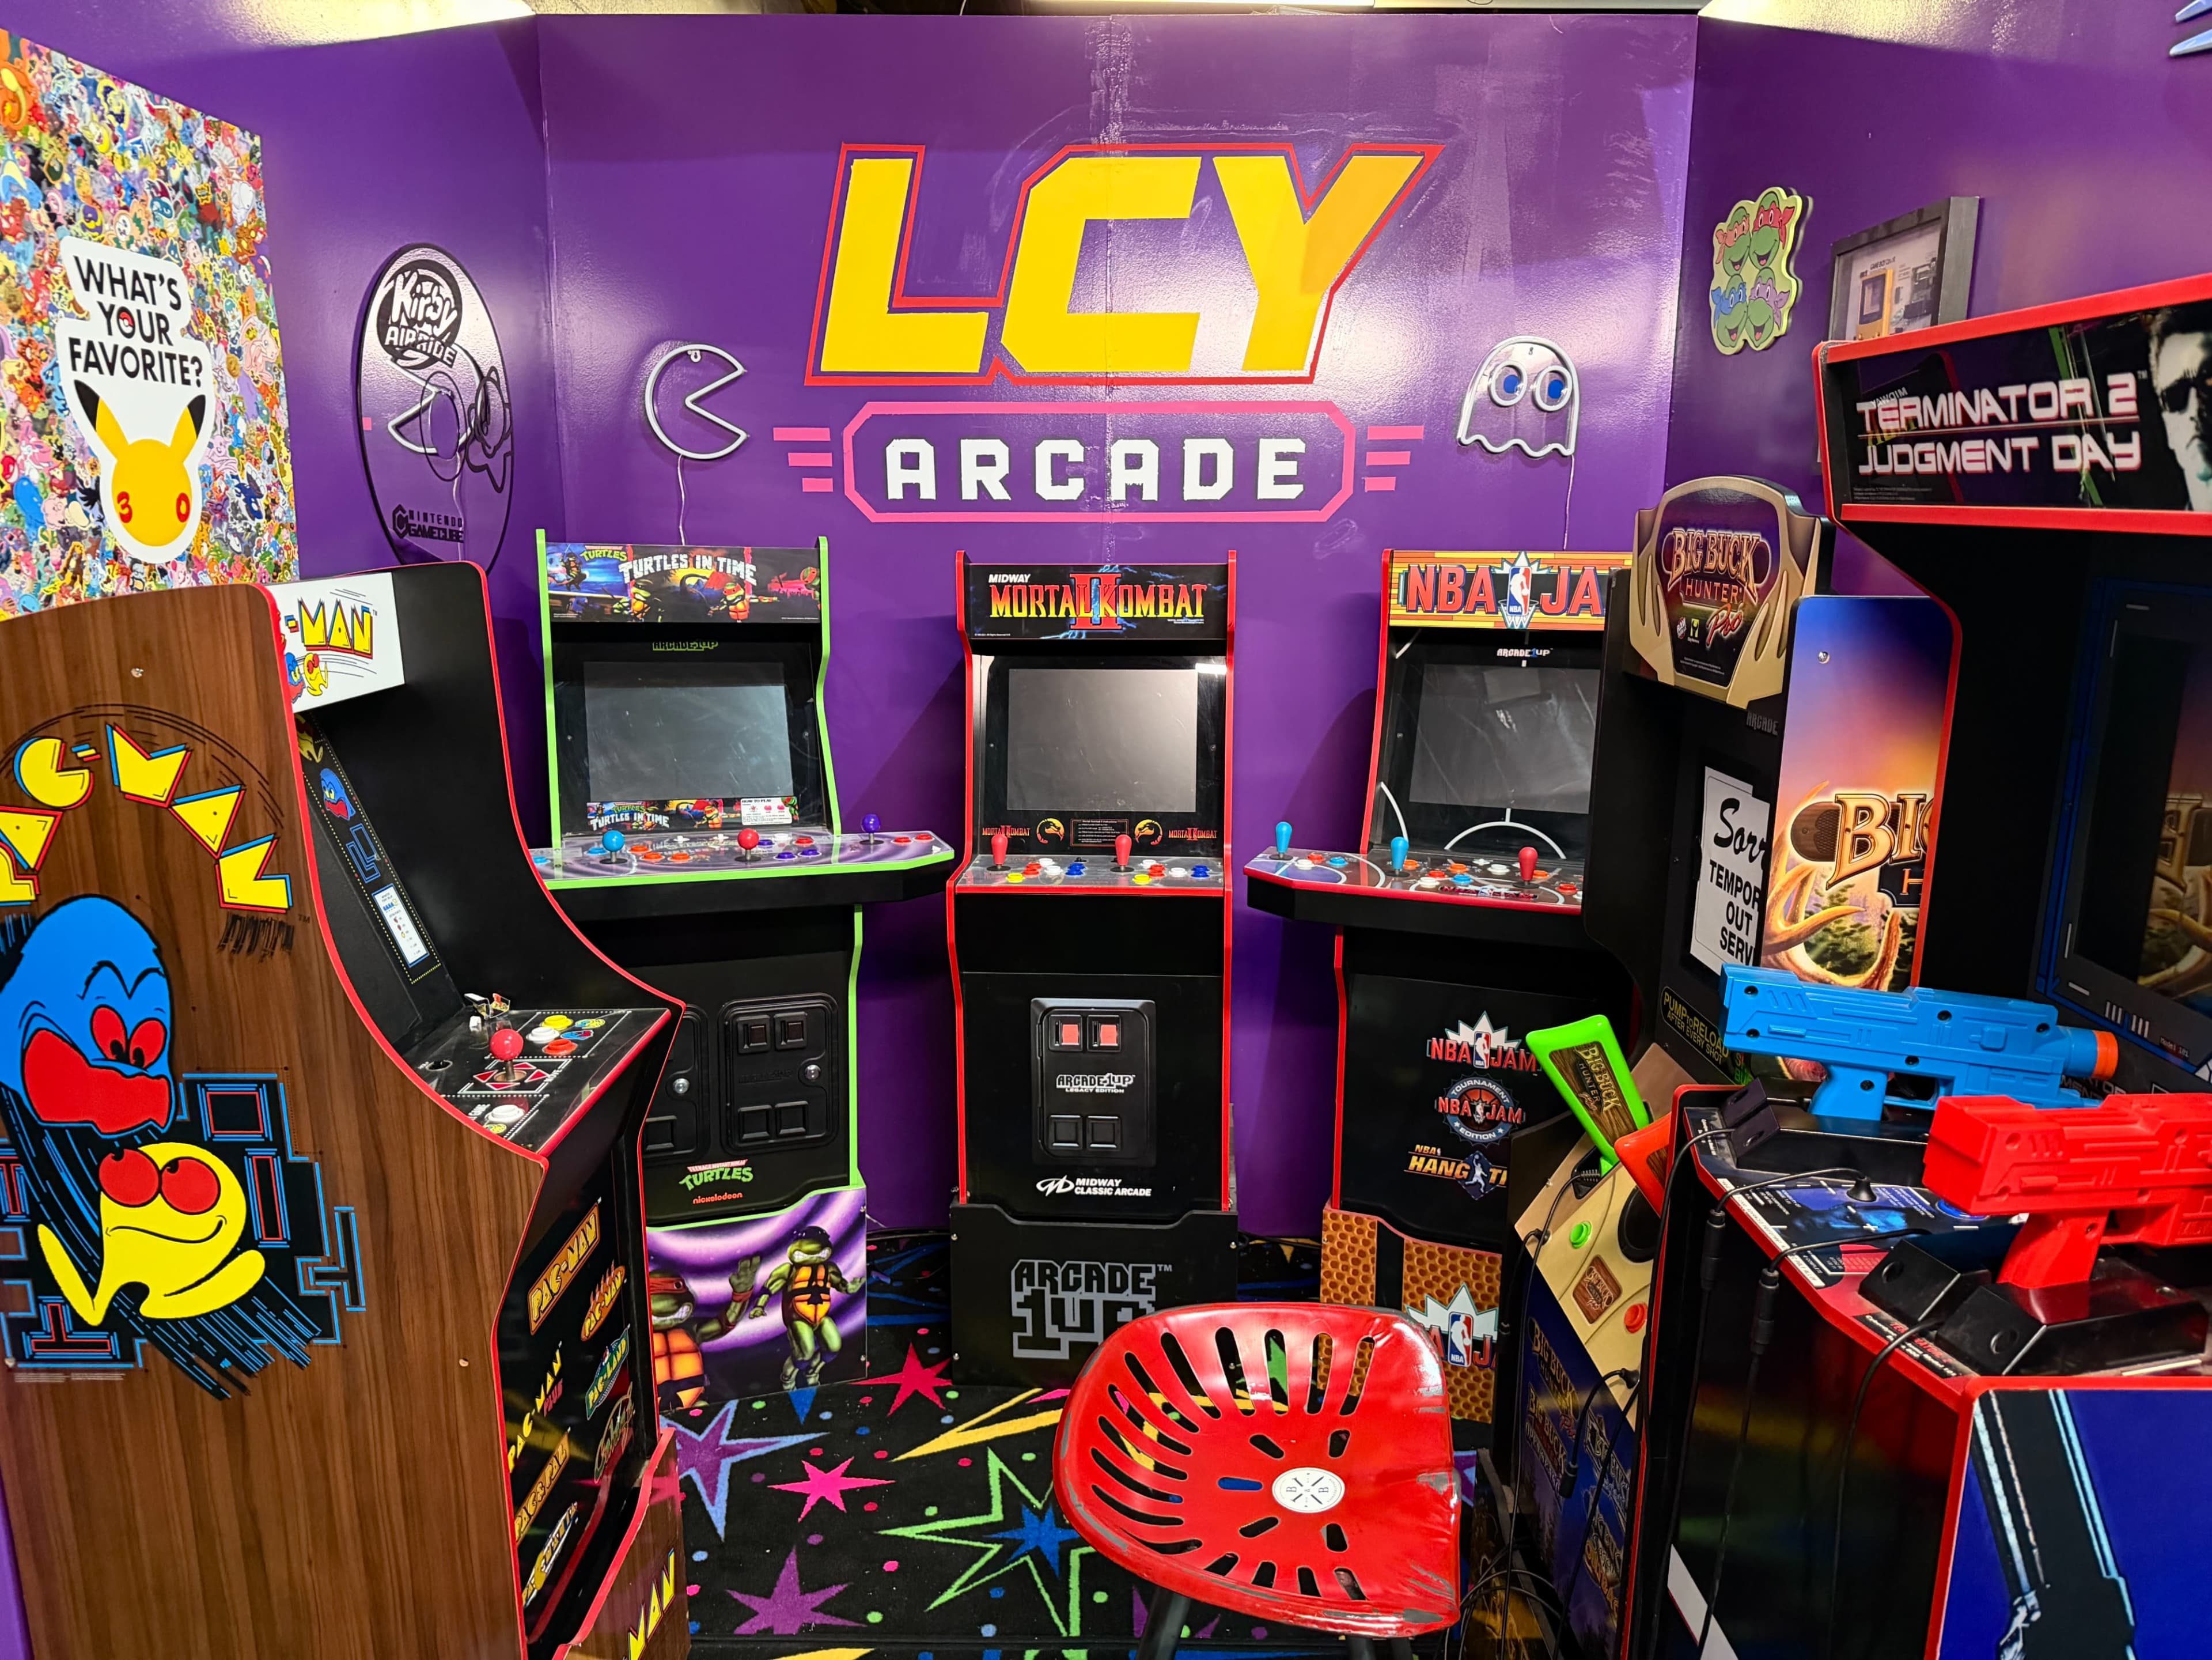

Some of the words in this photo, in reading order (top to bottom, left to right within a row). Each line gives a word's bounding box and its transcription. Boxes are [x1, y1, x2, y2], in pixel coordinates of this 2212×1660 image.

[815, 152, 1427, 376] LCY
[392, 271, 457, 338] Kirby
[97, 301, 173, 346] YOUR
[69, 336, 202, 387] FAVORITE?
[1856, 378, 2095, 433] TERMINATOR
[2107, 372, 2139, 416] 2
[885, 438, 1305, 500] ARCADE
[1858, 436, 2040, 475] JUDGMENT
[2051, 432, 2142, 474] DAY
[408, 509, 463, 528] NINTENDO
[408, 523, 464, 543] GAMECUBE
[579, 549, 627, 562] TURTLES
[618, 553, 689, 585] TURTLES
[696, 554, 713, 570] IN
[717, 555, 758, 587] TIME
[1668, 528, 1703, 591] BIG
[1703, 531, 1758, 605] BUCK
[988, 574, 1031, 584] MIDWAY
[1406, 564, 1499, 615] NBA
[1539, 565, 1611, 617] JA
[1685, 578, 1741, 604] HUNTER
[989, 584, 1093, 618] MORTAL
[1097, 583, 1208, 618] KOMBAT
[1509, 606, 1522, 614] NBA
[590, 812, 630, 831] TURTLES
[634, 812, 645, 821] IN
[646, 813, 670, 829] TIME
[1006, 827, 1031, 838] KOMBAT
[1168, 830, 1192, 838] MORTAL
[1192, 830, 1217, 839] KOMBAT
[1726, 901, 1753, 936] OUT
[1664, 992, 1688, 1020] PUMP
[1686, 1015, 1694, 1027] TO
[1430, 1037, 1471, 1064] NBA
[1490, 1046, 1537, 1072] JAM
[1666, 1012, 1685, 1033] AFTER
[1685, 1026, 1705, 1049] EVERY
[1705, 1043, 1724, 1065] SHOT
[1451, 1079, 1510, 1105] TOURNAMENT
[1574, 1043, 1603, 1073] BIG
[1596, 1069, 1622, 1112] BUCK
[1578, 1062, 1601, 1103] HUNTER
[1437, 1096, 1472, 1117] NBA
[1485, 1104, 1523, 1125] JAM
[1414, 1144, 1437, 1155] NBA
[1459, 1126, 1497, 1140] EDITION
[679, 1167, 754, 1192] TURTLES
[1075, 1178, 1122, 1187] MIDWAY
[1408, 1155, 1471, 1179] HANG
[692, 1192, 744, 1204] nickelodeon
[1074, 1187, 1114, 1196] CLASSIC
[1114, 1188, 1153, 1197] ARCADE
[531, 1213, 598, 1322] PAC-MAN
[1012, 1259, 1156, 1296] ARCADE
[584, 1270, 623, 1337] PAC-MAN
[588, 1337, 627, 1410] PAC-LAND
[1450, 1354, 1464, 1364] NBA
[1531, 1322, 1551, 1361] BIG
[1548, 1348, 1580, 1420] BUCK
[507, 1348, 562, 1474] PAC-MAN
[543, 1378, 564, 1419] PLUS
[1528, 1383, 1544, 1422] BIG
[1541, 1409, 1567, 1470] BUCK
[514, 1493, 538, 1542] PAC
[536, 1482, 547, 1502] &
[545, 1445, 568, 1491] PAL
